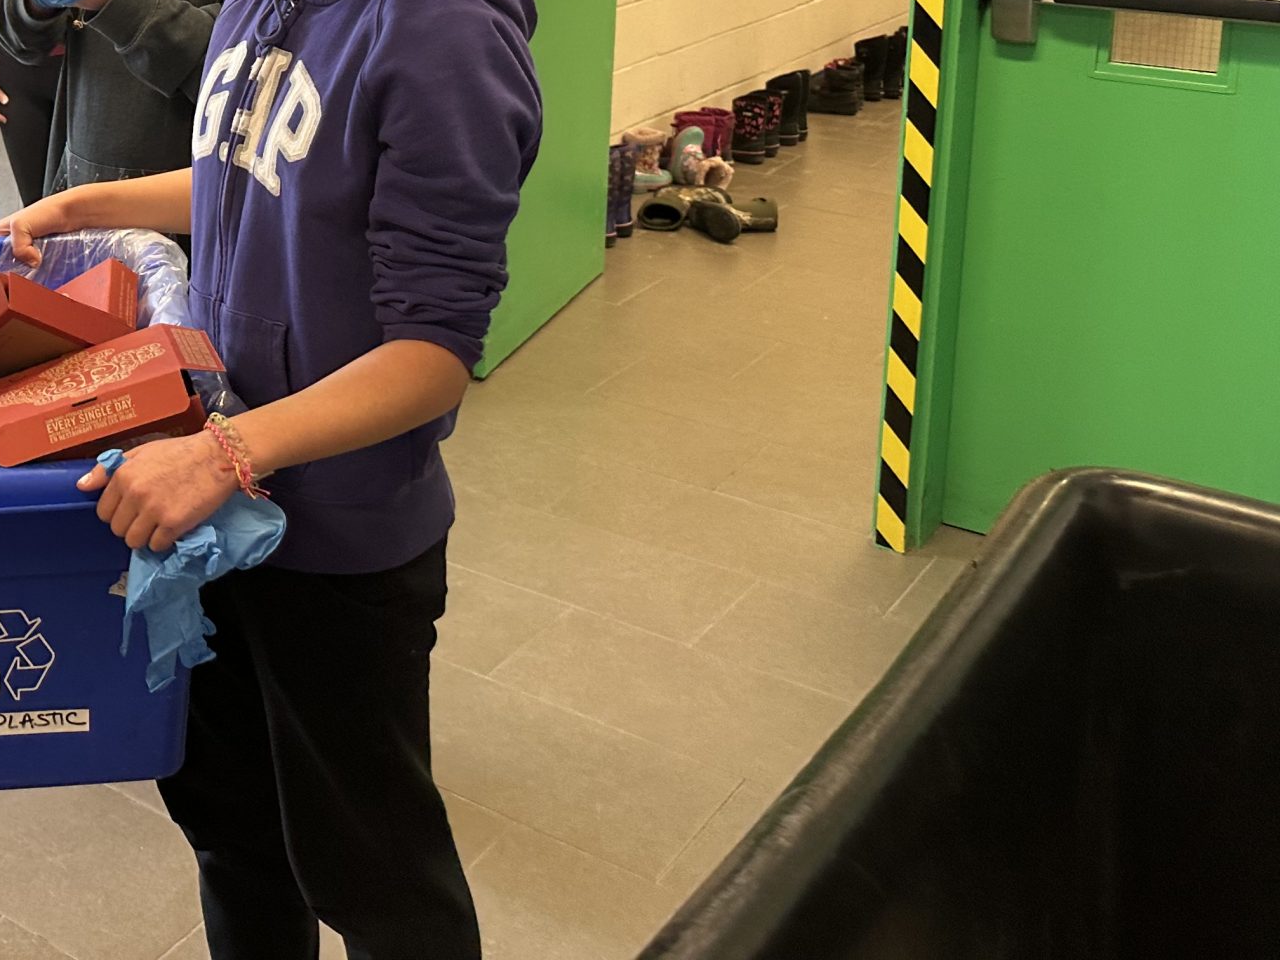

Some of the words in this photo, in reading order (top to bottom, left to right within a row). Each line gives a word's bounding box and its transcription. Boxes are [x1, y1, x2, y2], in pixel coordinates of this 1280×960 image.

[192, 40, 322, 196] GAP
[46, 416, 76, 434] EVERY
[78, 405, 113, 423] SINGLE
[114, 398, 136, 412] DAY.
